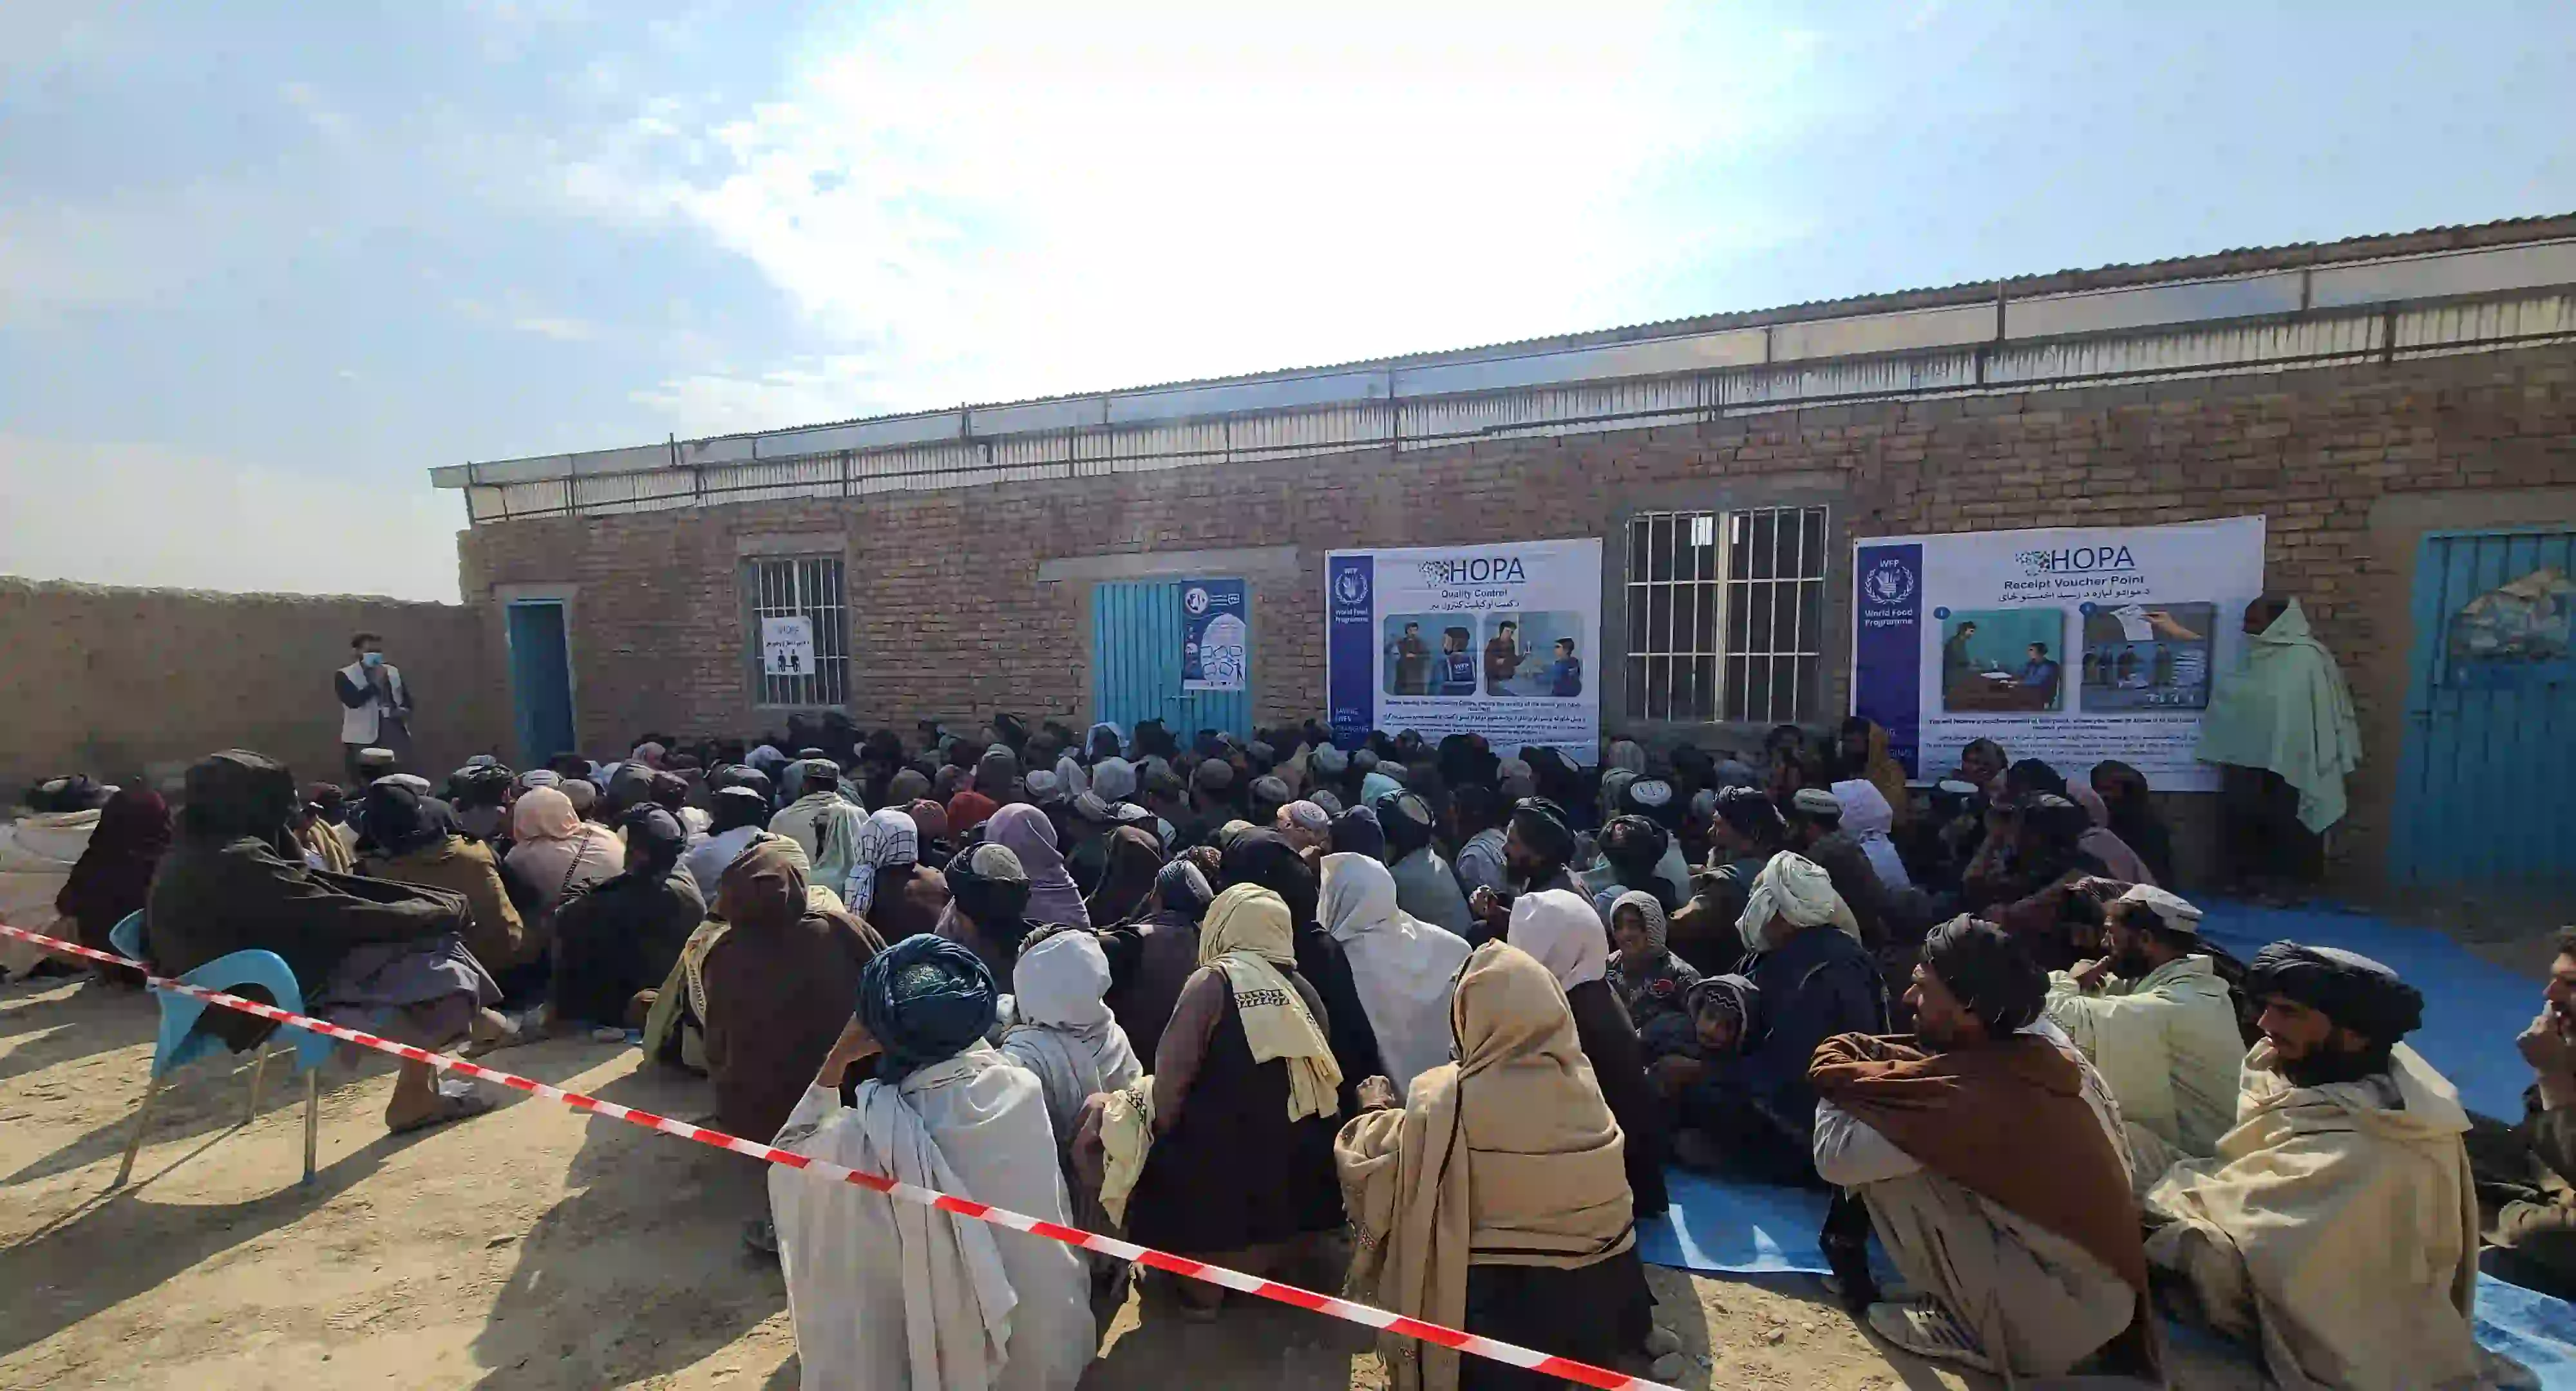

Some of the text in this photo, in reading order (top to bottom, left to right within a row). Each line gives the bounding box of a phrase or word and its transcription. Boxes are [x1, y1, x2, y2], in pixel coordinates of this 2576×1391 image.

[2051, 546, 2135, 569] HOPA
[1450, 557, 1525, 582] HOPA
[2055, 576, 2107, 588] Voucher
[2111, 575, 2144, 585] Point
[1441, 589, 1507, 600] Quality Control
[1865, 607, 1913, 616] World Food
